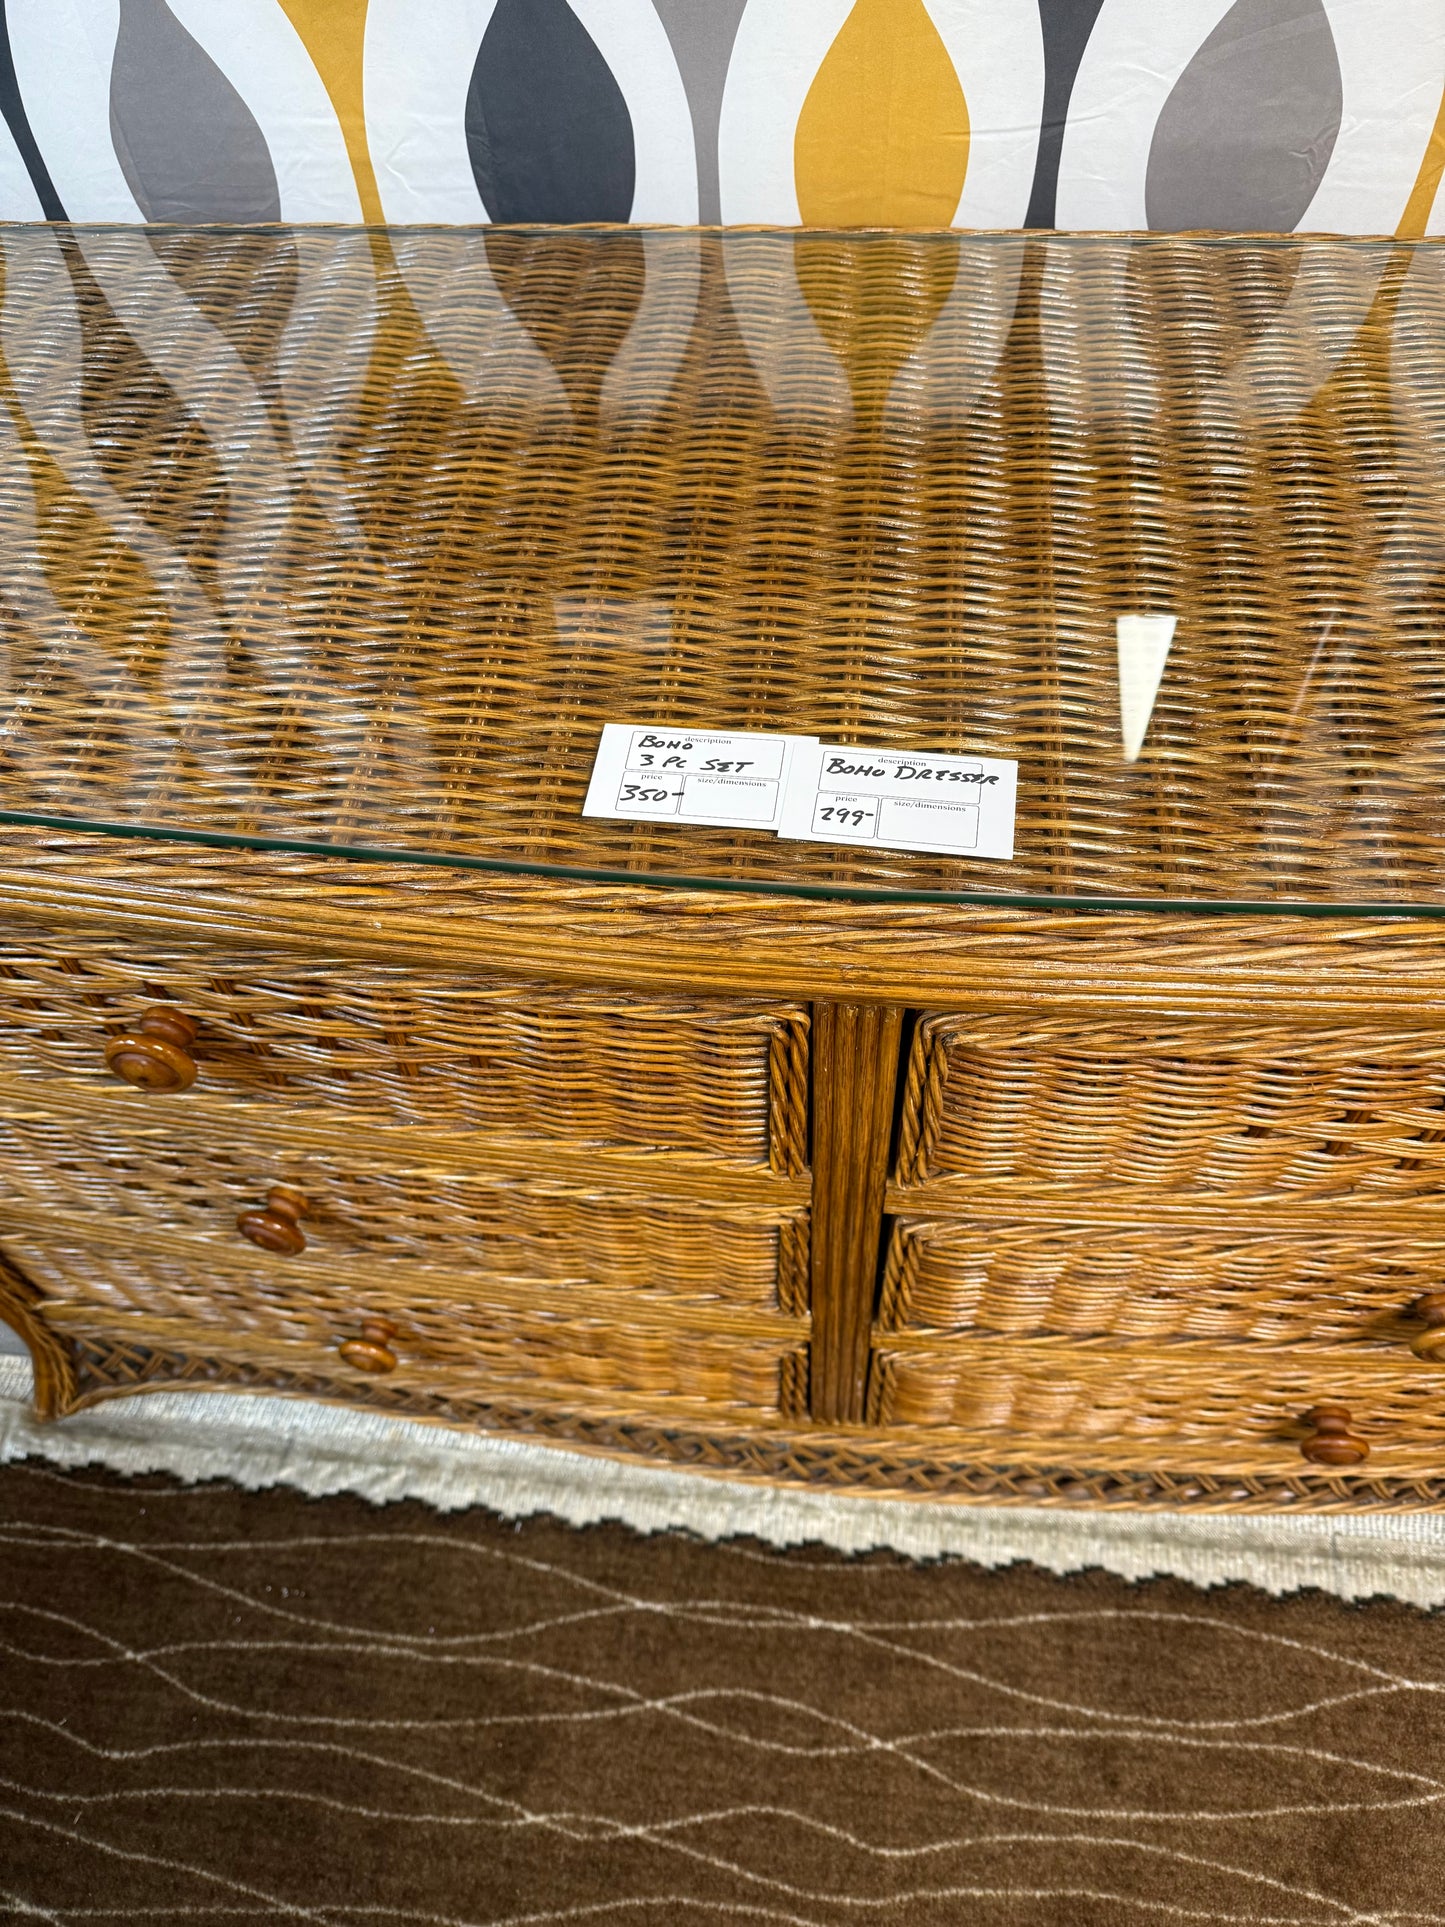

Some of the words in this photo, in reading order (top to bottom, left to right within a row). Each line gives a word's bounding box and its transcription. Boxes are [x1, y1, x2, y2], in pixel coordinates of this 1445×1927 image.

[685, 736, 732, 745] description
[640, 754, 654, 767] 3
[699, 759, 754, 773] SET
[878, 757, 927, 767] description
[894, 766, 999, 785] DRESSER
[697, 777, 767, 787] size/dimensions
[894, 801, 966, 812] size/dimensions
